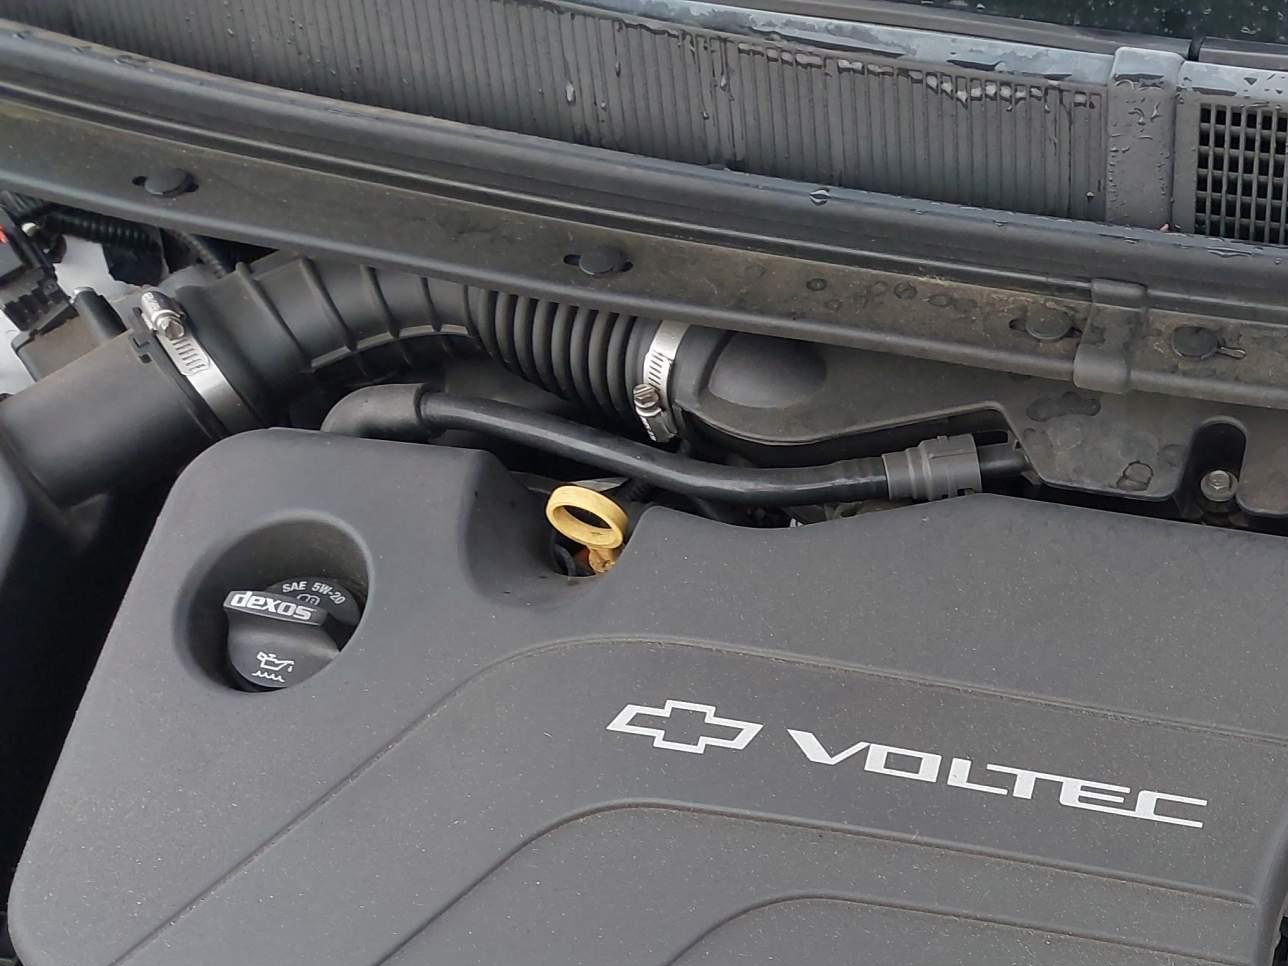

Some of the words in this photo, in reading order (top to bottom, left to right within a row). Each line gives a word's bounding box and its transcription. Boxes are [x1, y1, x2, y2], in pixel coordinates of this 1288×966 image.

[231, 592, 316, 620] dexos
[283, 581, 307, 592] SAE
[312, 583, 346, 604] 5W-20
[788, 728, 1208, 828] VOLTEC
